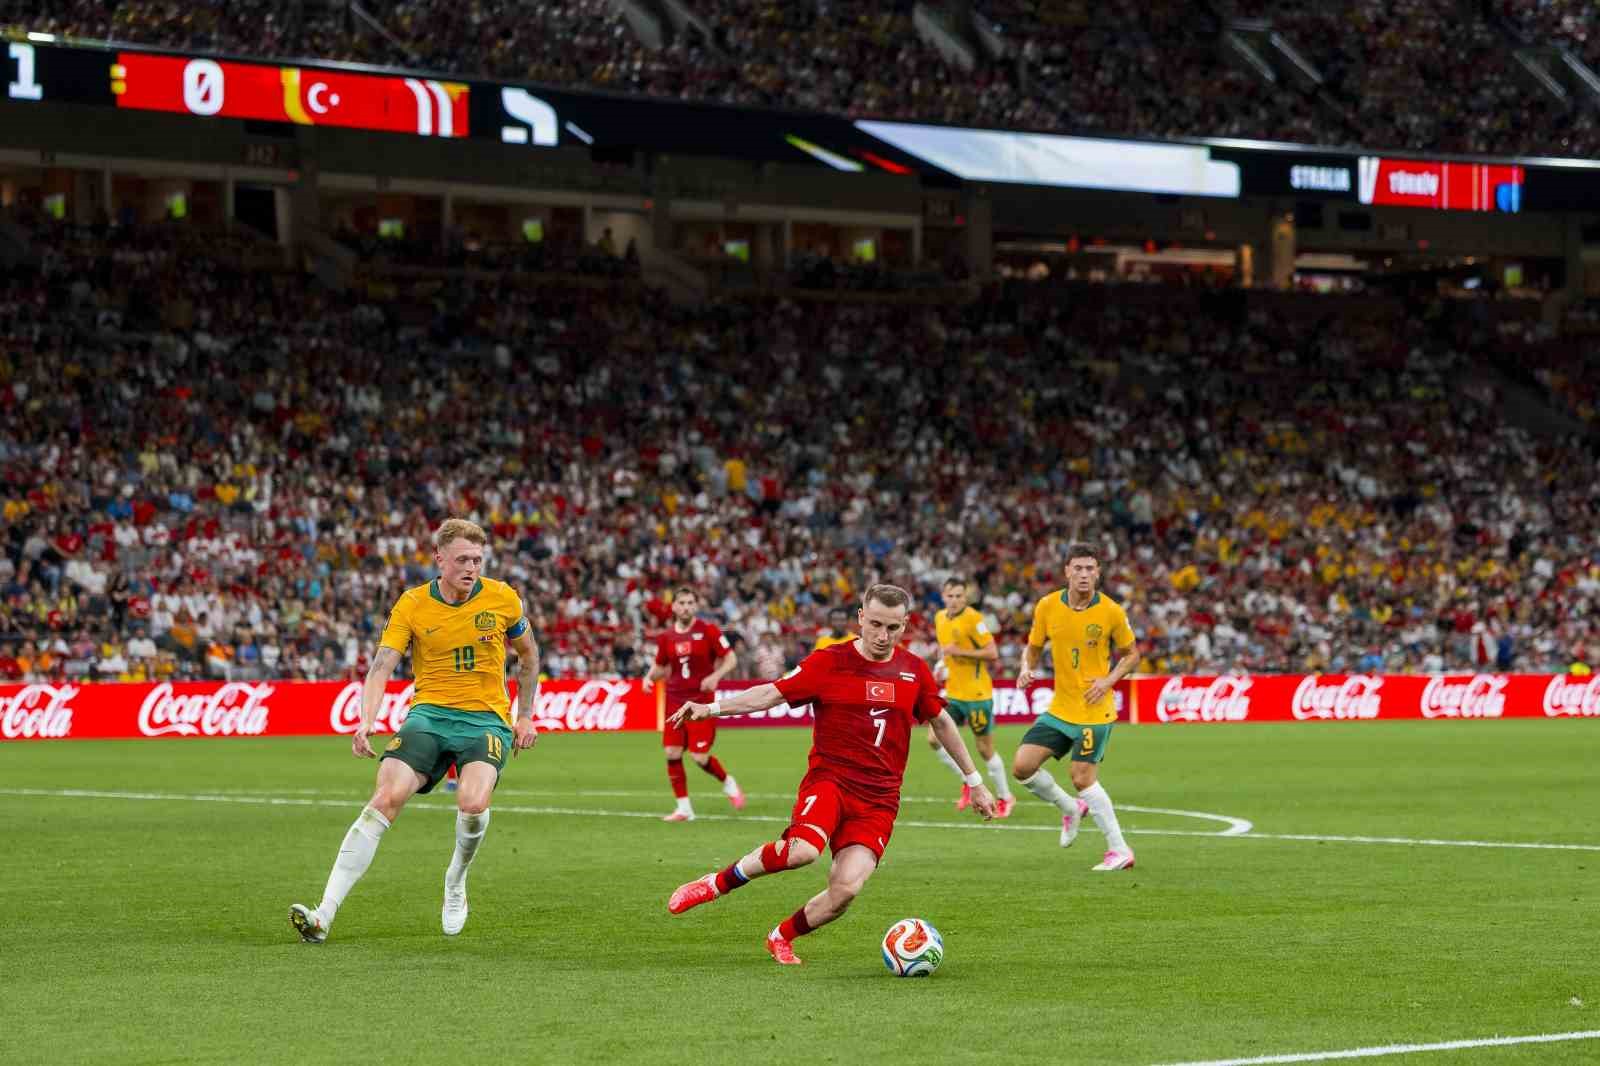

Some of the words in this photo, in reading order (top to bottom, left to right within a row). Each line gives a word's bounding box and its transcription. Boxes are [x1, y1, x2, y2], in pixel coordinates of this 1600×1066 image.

[8, 42, 43, 100] 1
[183, 58, 225, 116] 0
[453, 646, 475, 672] 19
[1072, 648, 1080, 669] 3
[138, 682, 275, 736] Coca-Cola
[1156, 674, 1254, 722] Coca-Cola
[1292, 674, 1384, 720] Coca-Cola
[1421, 674, 1509, 719] Coca-Cola
[486, 733, 503, 759] 19
[872, 718, 887, 748] 7
[1082, 728, 1094, 750] 3
[800, 794, 818, 816] 7
